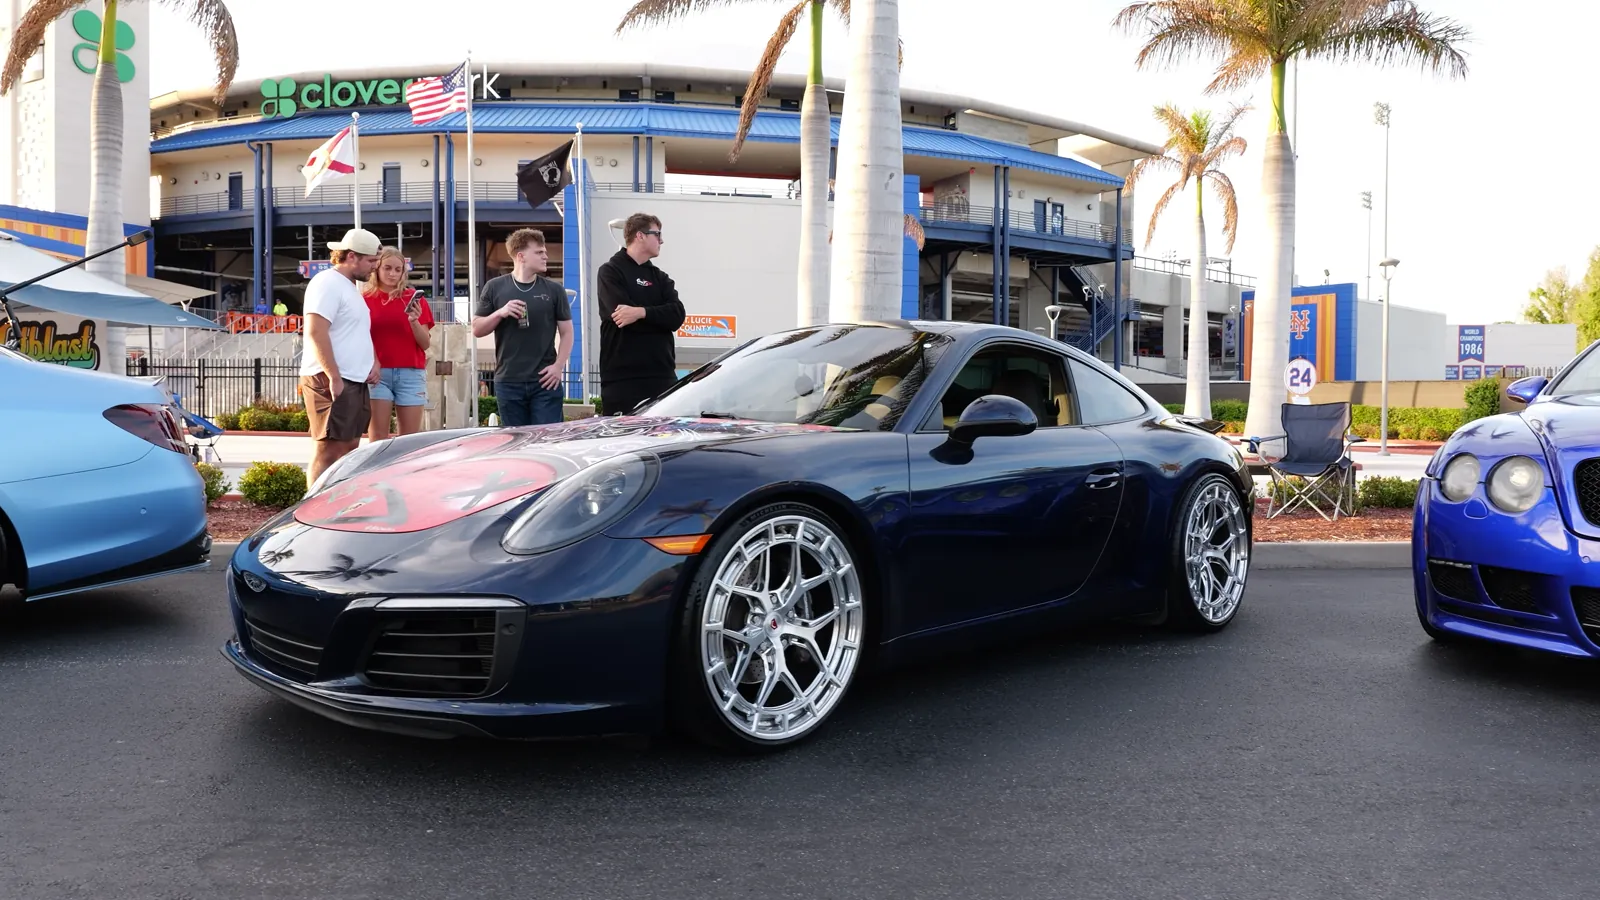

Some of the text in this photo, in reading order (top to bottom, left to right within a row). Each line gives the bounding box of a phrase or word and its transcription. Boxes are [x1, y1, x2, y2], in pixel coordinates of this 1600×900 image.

[301, 73, 413, 108] clover
[690, 316, 712, 324] LUCIE
[1460, 343, 1483, 355] 1986
[1290, 368, 1312, 387] 24
